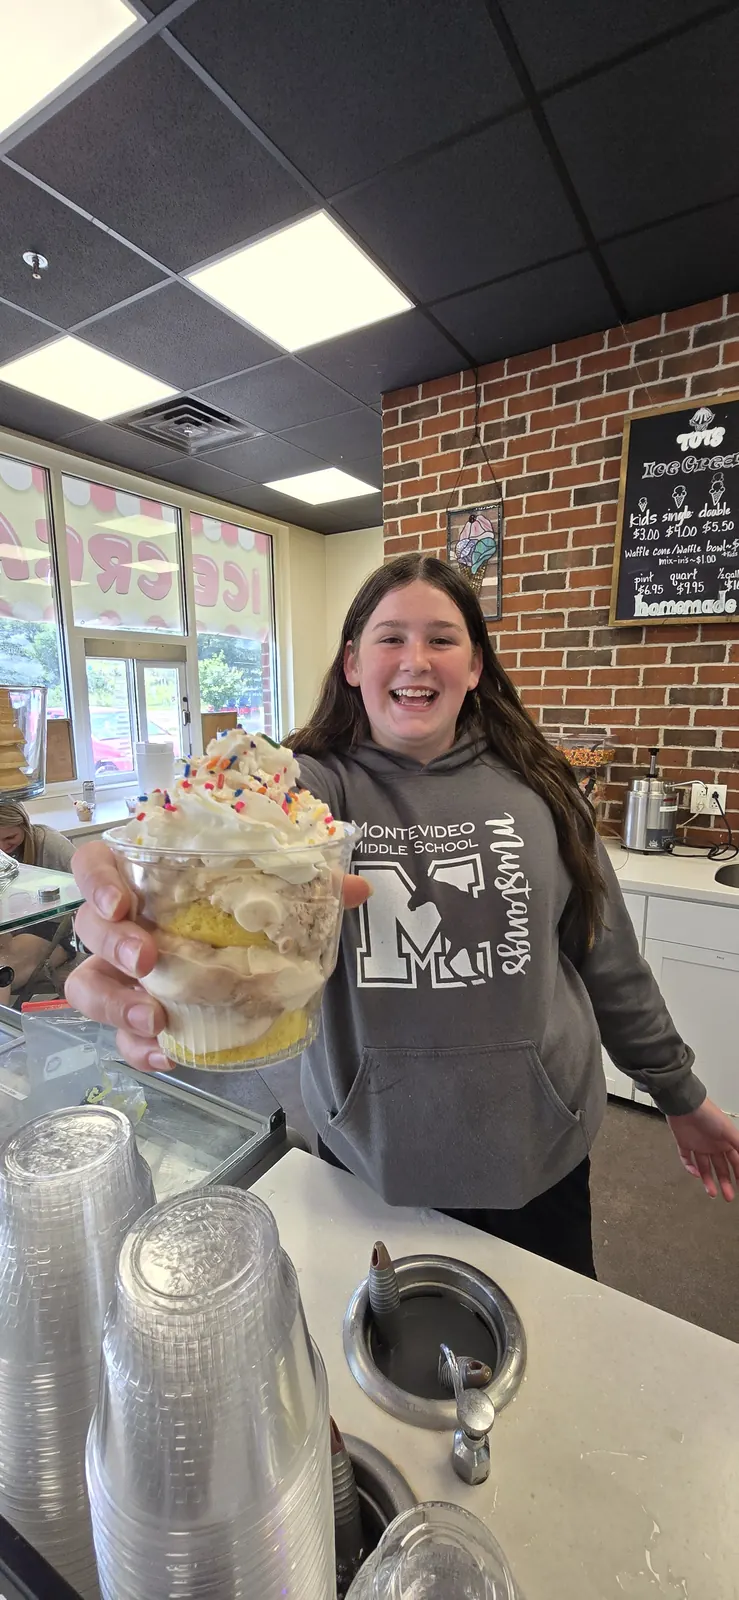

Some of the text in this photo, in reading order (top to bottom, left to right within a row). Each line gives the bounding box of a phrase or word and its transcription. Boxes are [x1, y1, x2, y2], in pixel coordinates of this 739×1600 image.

[698, 501, 731, 518] double
[632, 527, 660, 541] $3.00
[702, 520, 735, 534] $5.50
[634, 571, 654, 591] pint
[669, 568, 698, 587] quart
[637, 584, 664, 596] $6.95
[676, 581, 705, 596] $9.95
[633, 590, 738, 617] homemade
[413, 838, 479, 854] SCHOOL
